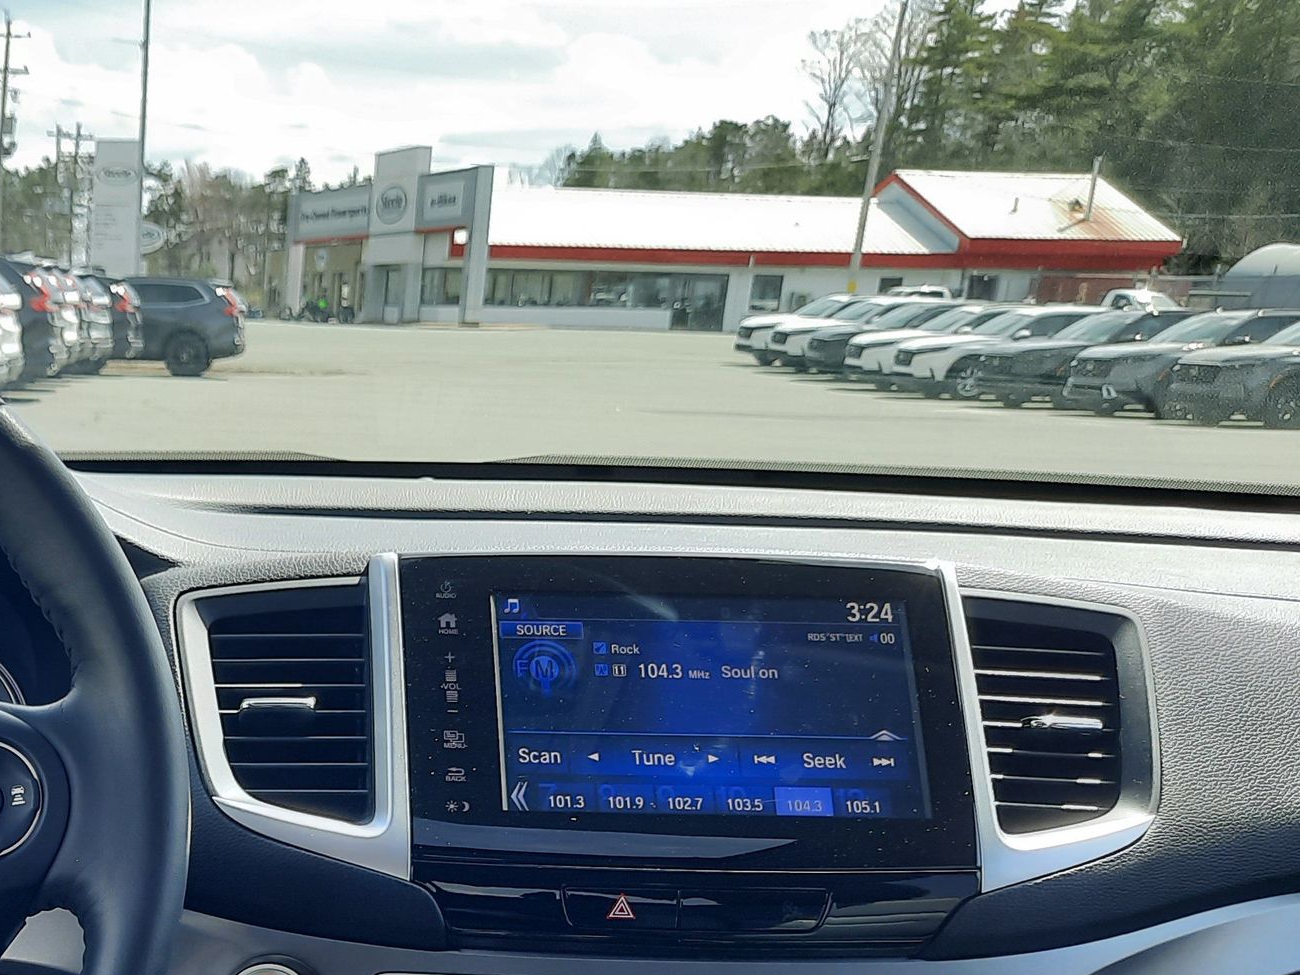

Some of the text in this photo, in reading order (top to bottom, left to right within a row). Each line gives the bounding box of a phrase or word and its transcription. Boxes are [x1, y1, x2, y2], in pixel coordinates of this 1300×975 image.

[846, 602, 893, 623] 3:24
[516, 624, 567, 636] SOURCE
[807, 632, 826, 641] RDS
[880, 632, 895, 644] 00
[611, 643, 640, 655] Rock
[638, 664, 683, 679] 104.3
[688, 669, 710, 679] MHz
[721, 665, 755, 679] Soul
[759, 668, 778, 679] on
[518, 748, 847, 769] Scan Tune Seek
[548, 795, 881, 813] 101.3 101.9 102.7 103.5 104.3 105.1
